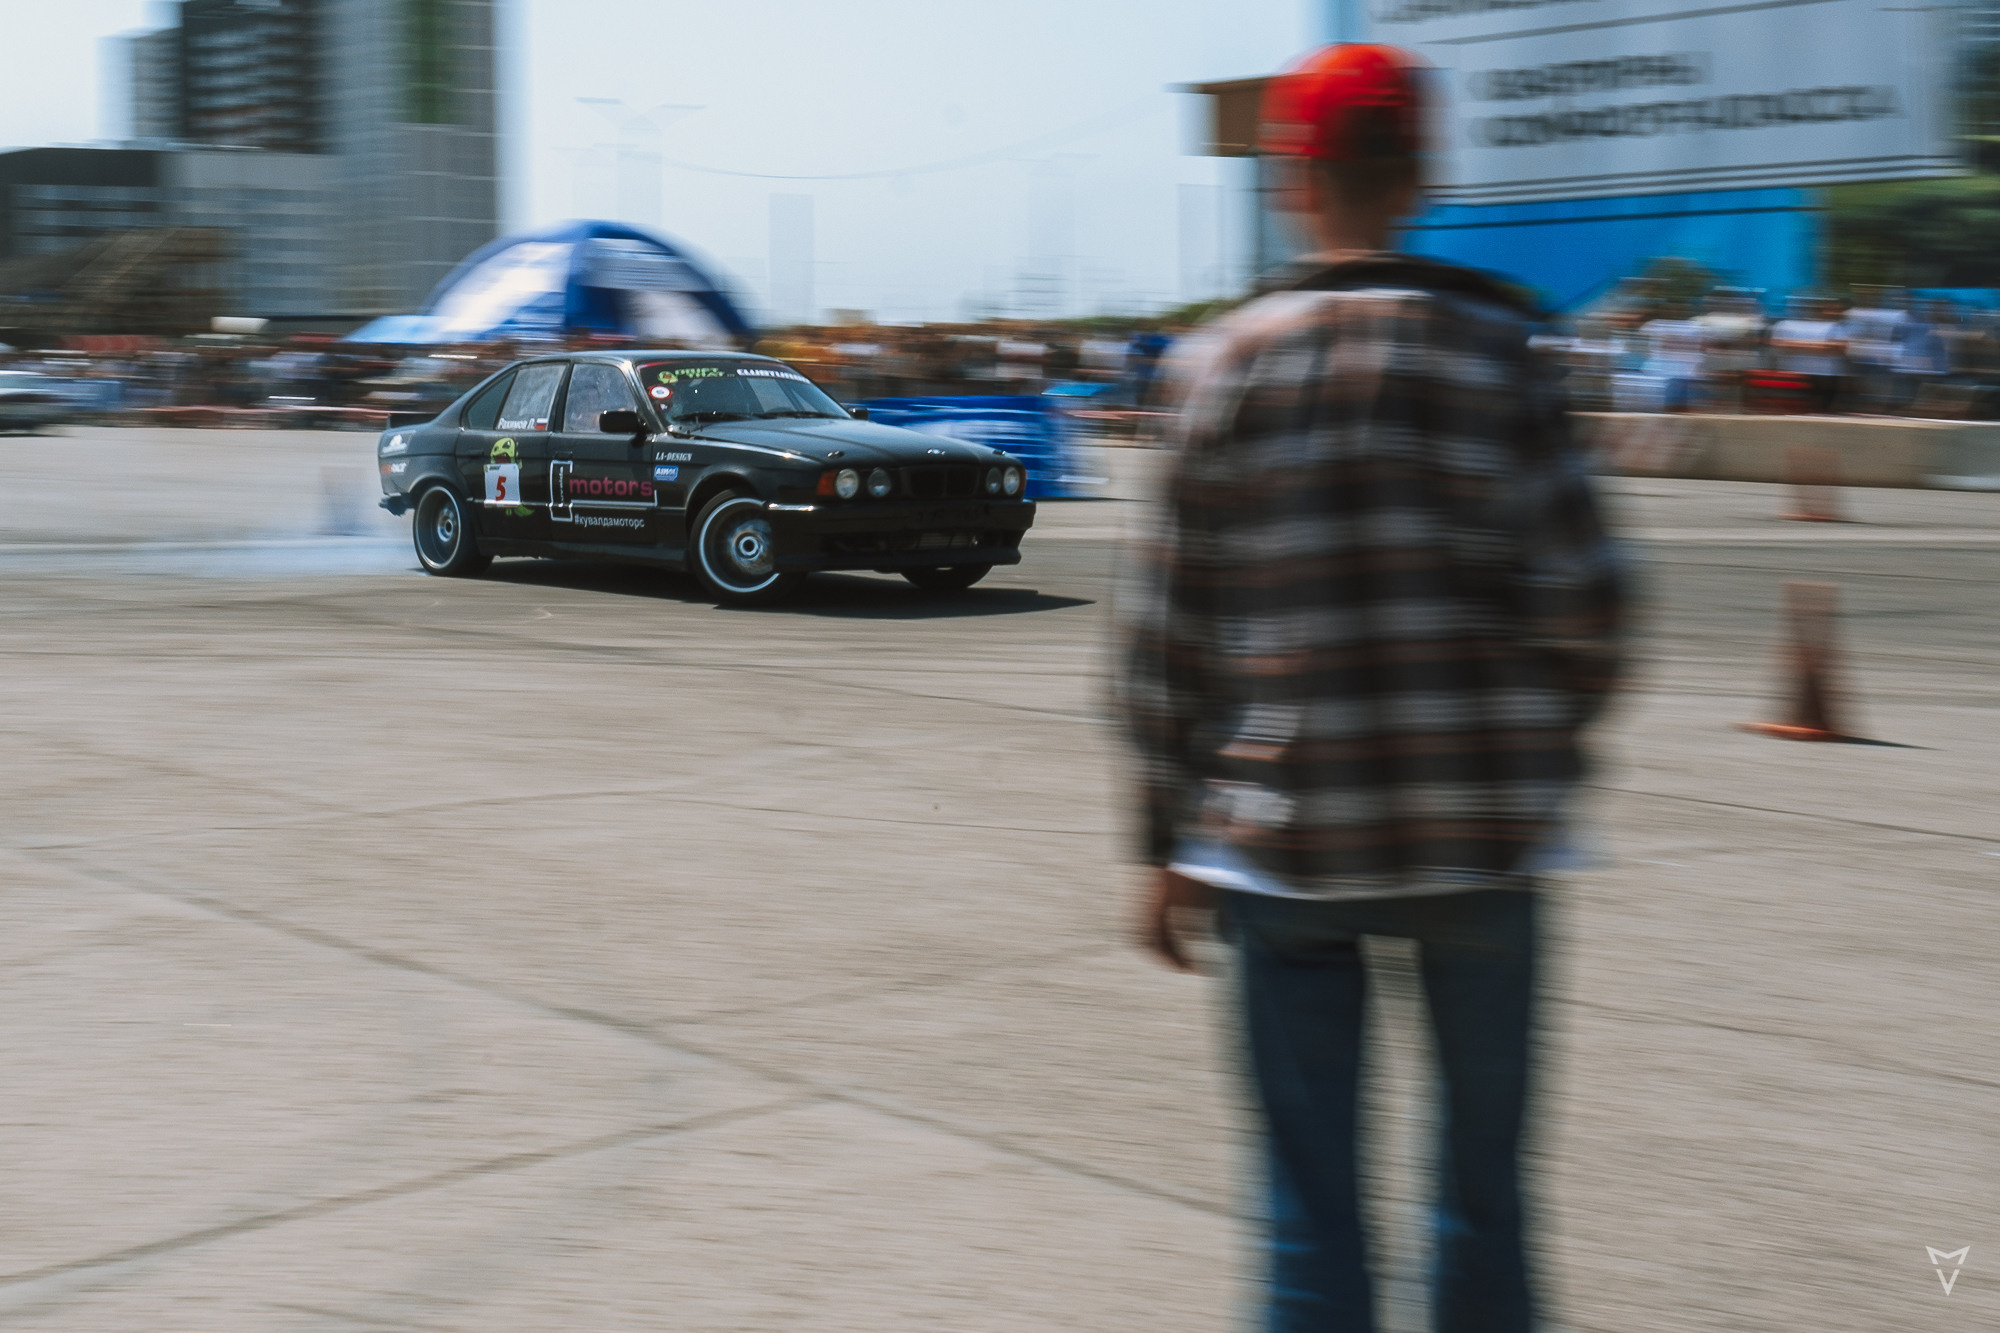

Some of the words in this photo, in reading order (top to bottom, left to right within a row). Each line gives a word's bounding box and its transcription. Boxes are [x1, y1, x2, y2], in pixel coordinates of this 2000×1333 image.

[655, 451, 693, 462] LA-DESIGN
[495, 475, 507, 501] 5
[569, 477, 653, 497] motors
[574, 514, 645, 530] #кувалдамоторс
